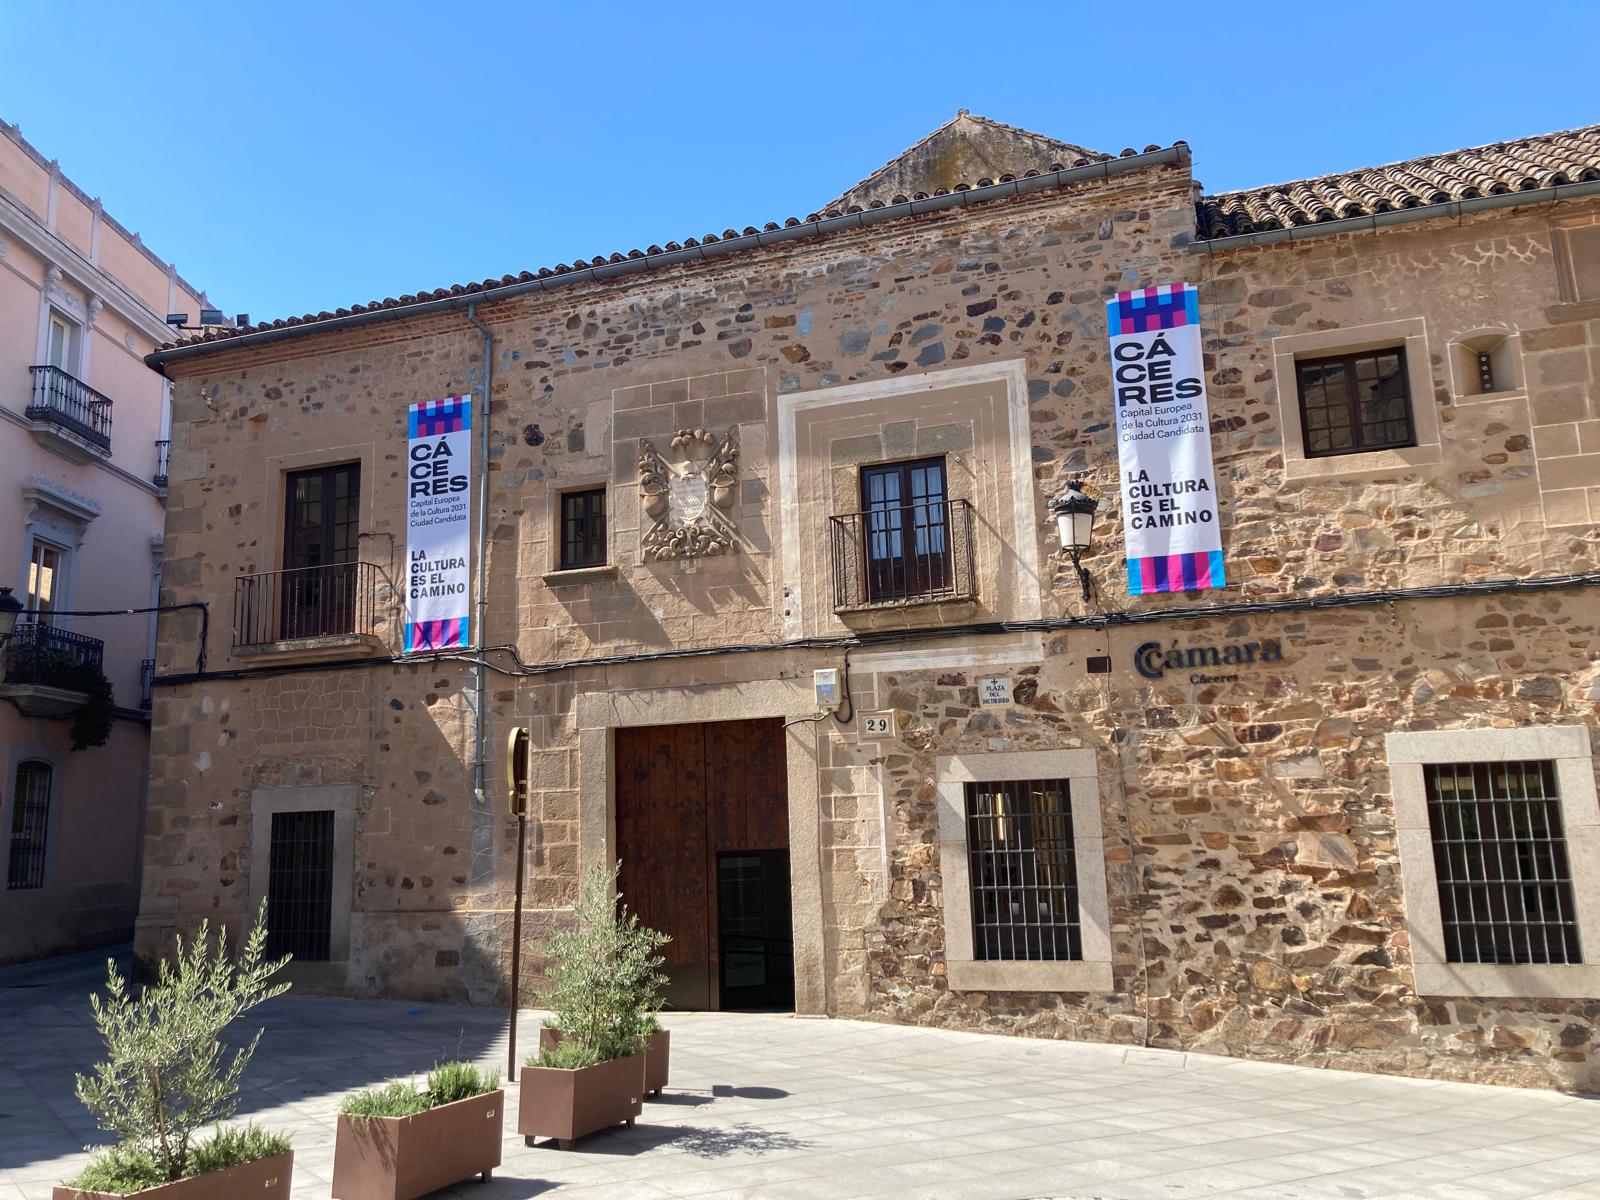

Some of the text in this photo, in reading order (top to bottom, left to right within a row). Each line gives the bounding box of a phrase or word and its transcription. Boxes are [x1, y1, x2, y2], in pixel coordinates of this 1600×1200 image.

[1114, 332, 1177, 361] CÁ
[1116, 360, 1172, 384] CE
[1118, 378, 1202, 407] RES
[1120, 403, 1192, 418] Capital Europea
[1122, 412, 1202, 430] de la Cultura 2031
[1122, 424, 1204, 442] Ciudad Candidata
[410, 436, 453, 462] CÁ
[410, 459, 449, 480] CE
[1128, 470, 1150, 484] LA
[410, 475, 468, 498] RES
[1128, 478, 1210, 498] CULTURA
[410, 496, 460, 508] Capital Europea
[410, 510, 420, 518] de
[427, 506, 450, 516] Cultura
[450, 503, 466, 512] 2031
[1130, 498, 1180, 514] ES EL
[410, 514, 466, 528] Ciudad Candidata
[1131, 510, 1212, 530] CAMINO
[412, 550, 426, 562] LA
[410, 557, 466, 574] CULTURA
[410, 572, 445, 586] ES EL
[410, 582, 466, 599] CAMINO
[1134, 640, 1284, 678] Cámara
[986, 684, 1005, 692] PLAZA
[867, 719, 887, 731] 29
